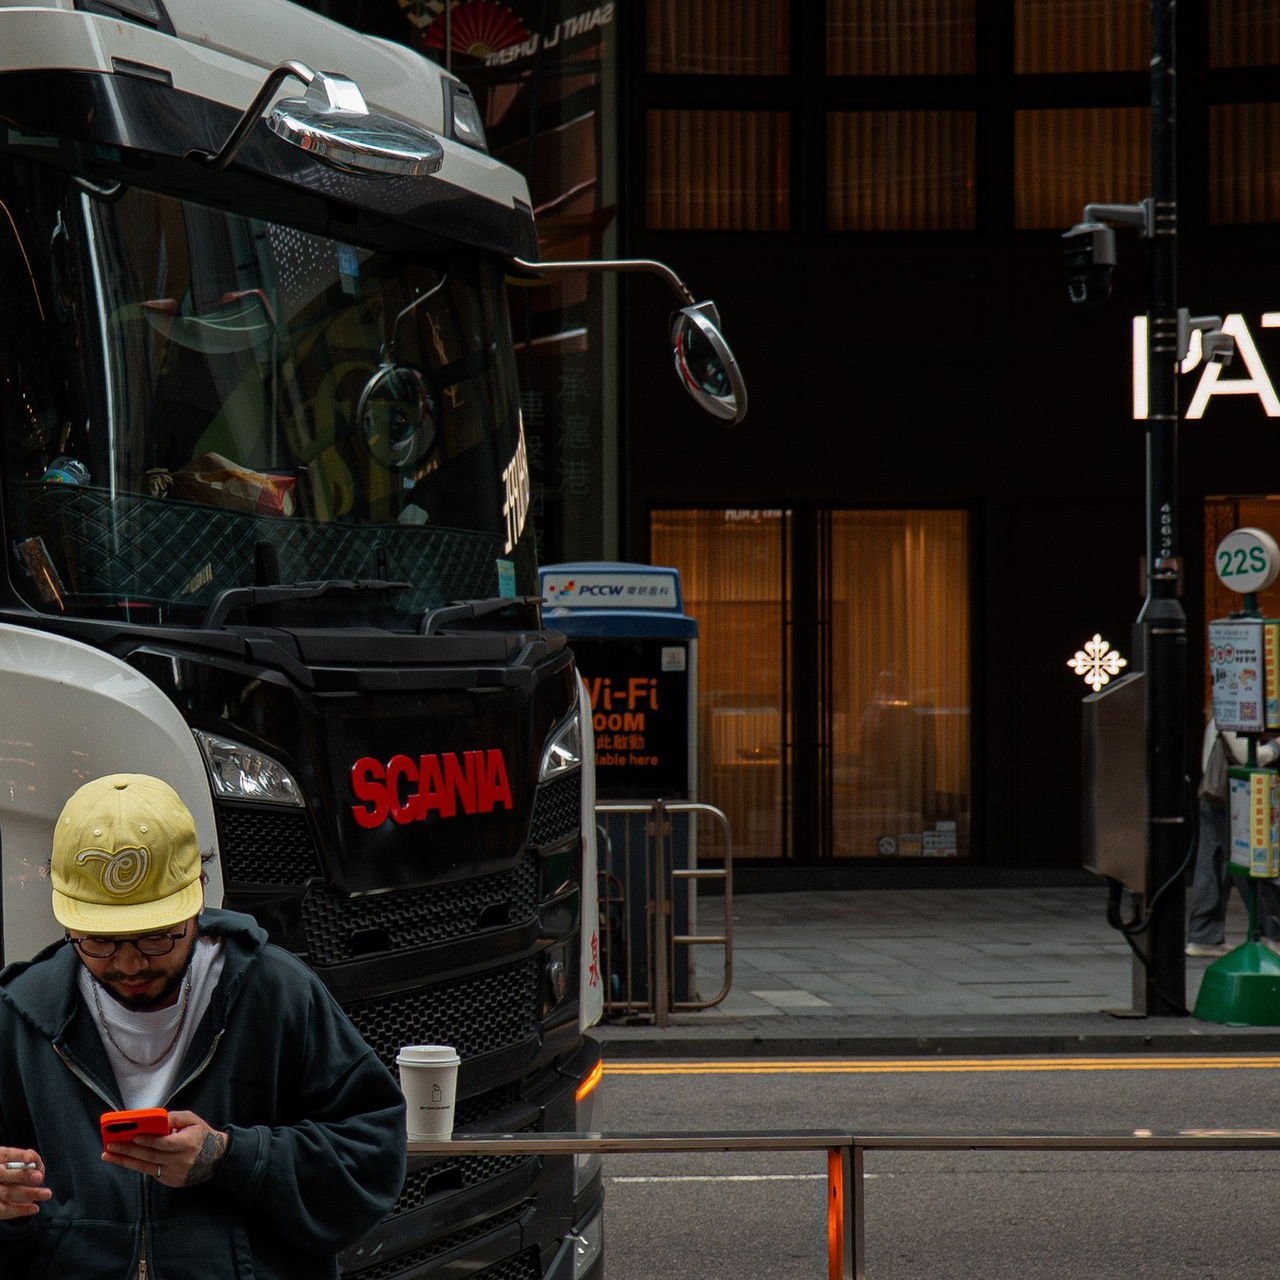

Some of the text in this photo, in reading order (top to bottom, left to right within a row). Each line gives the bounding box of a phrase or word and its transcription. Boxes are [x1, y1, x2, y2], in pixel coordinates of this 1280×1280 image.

[1218, 546, 1267, 577] 22S
[578, 585, 624, 596] PCCW
[629, 752, 659, 766] here
[351, 748, 514, 829] SCANIA
